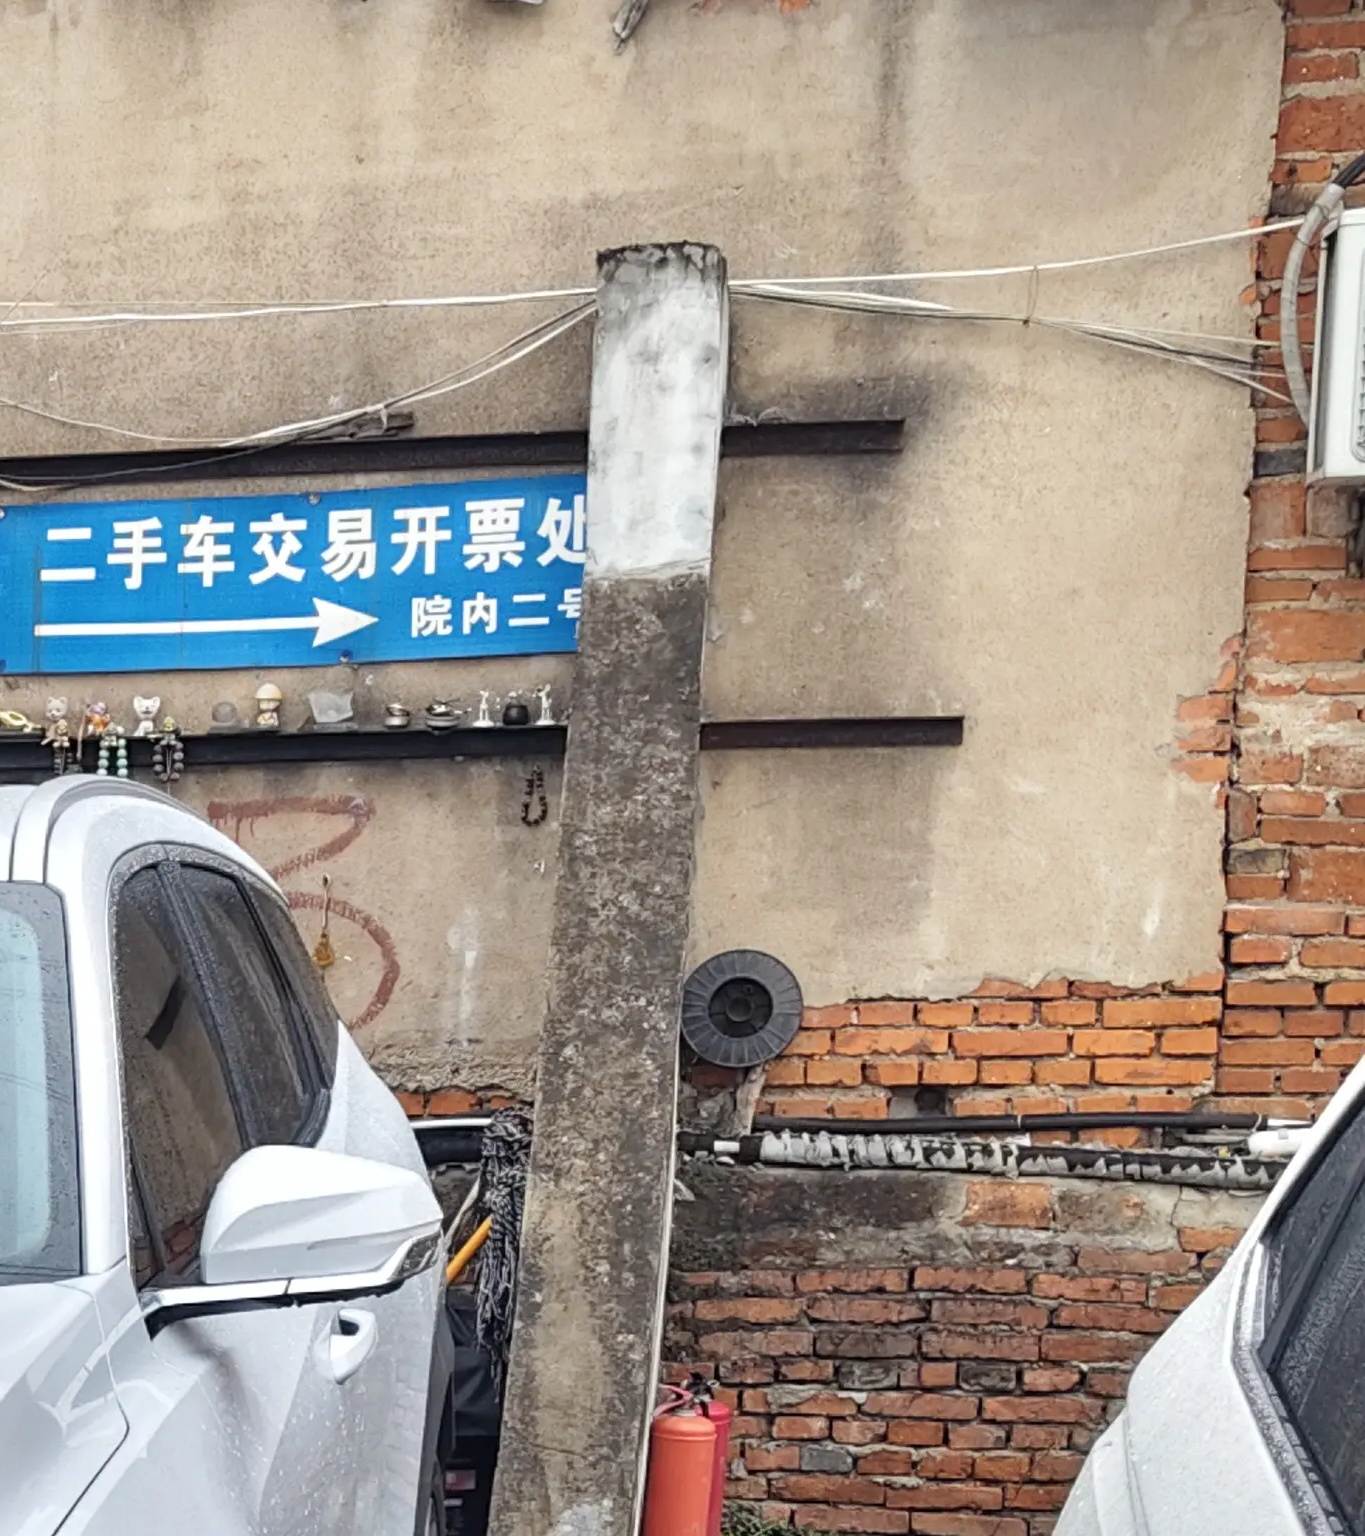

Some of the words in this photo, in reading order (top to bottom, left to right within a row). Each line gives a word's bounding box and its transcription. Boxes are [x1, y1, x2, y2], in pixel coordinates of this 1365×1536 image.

[38, 495, 586, 592] 二手车交易开票处
